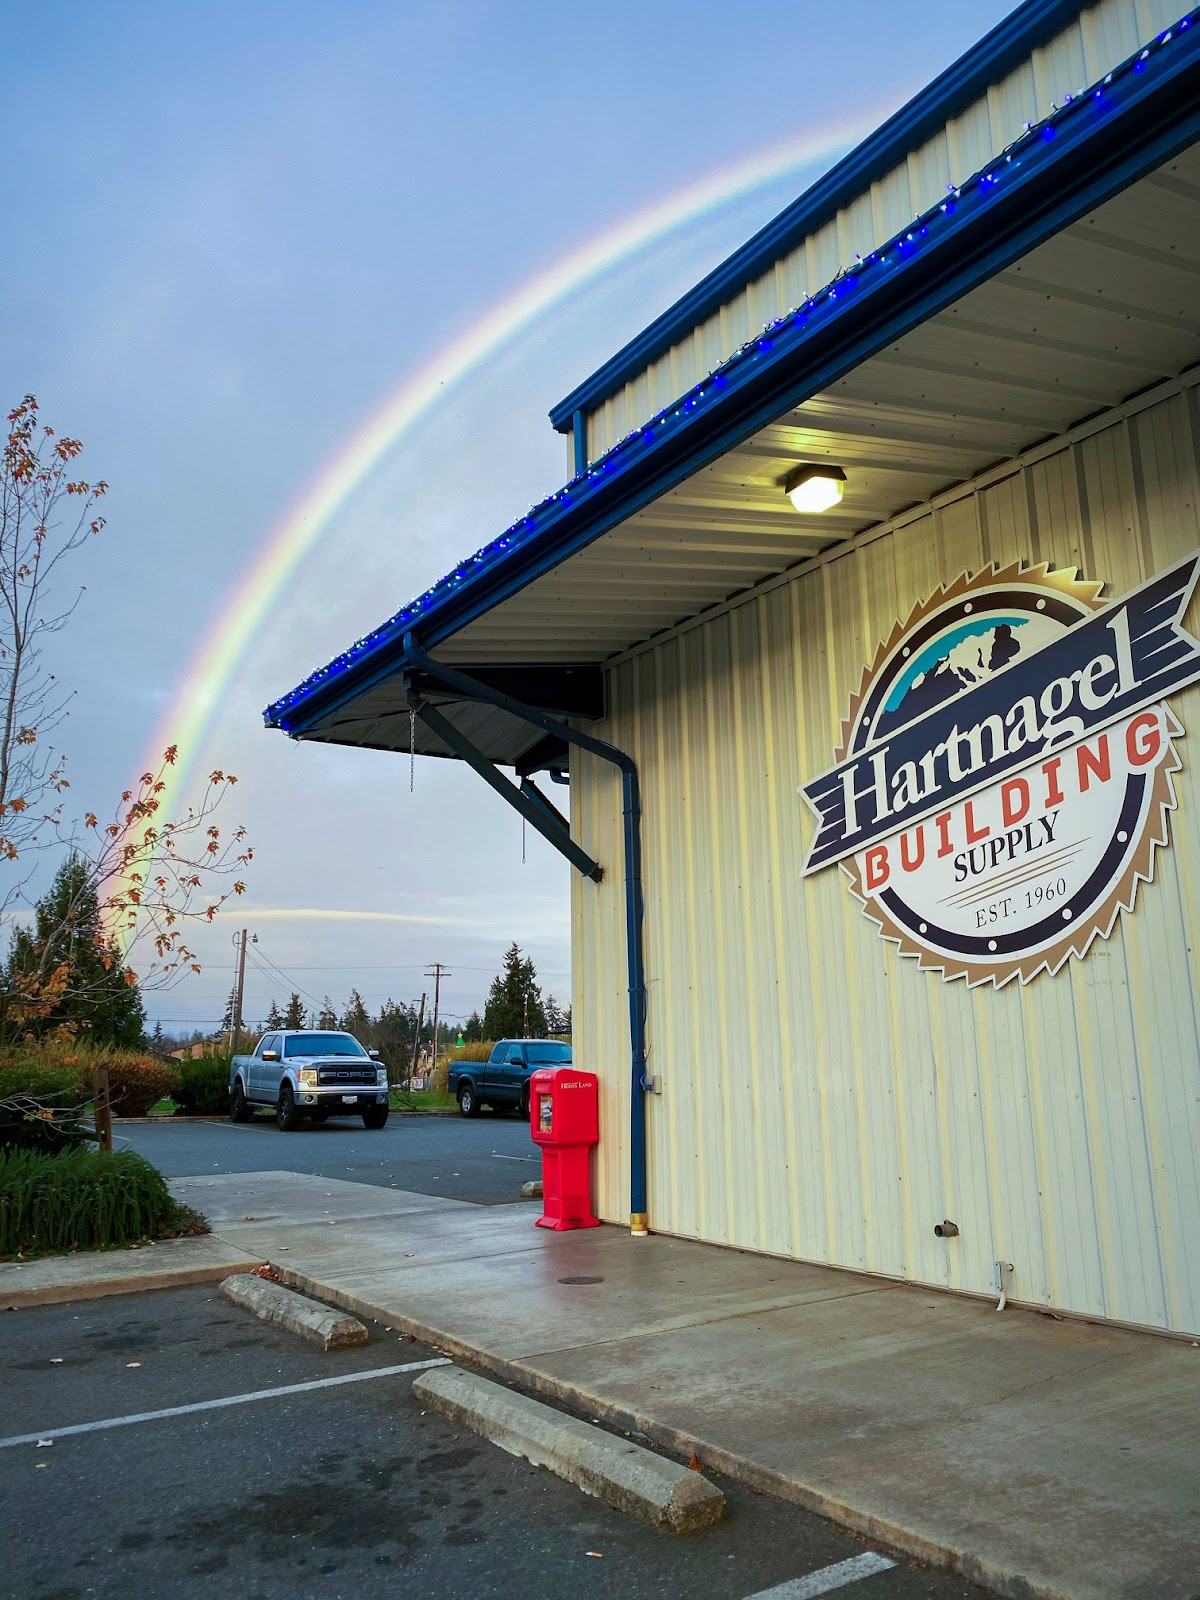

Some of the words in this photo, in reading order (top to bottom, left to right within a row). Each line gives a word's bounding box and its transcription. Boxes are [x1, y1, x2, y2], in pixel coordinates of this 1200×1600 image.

[838, 605, 1142, 840] Hartnagel
[865, 712, 1161, 891] BUILDING
[954, 810, 1060, 883] SUPPLY
[975, 901, 1016, 929] EST.
[1025, 877, 1067, 909] 1960
